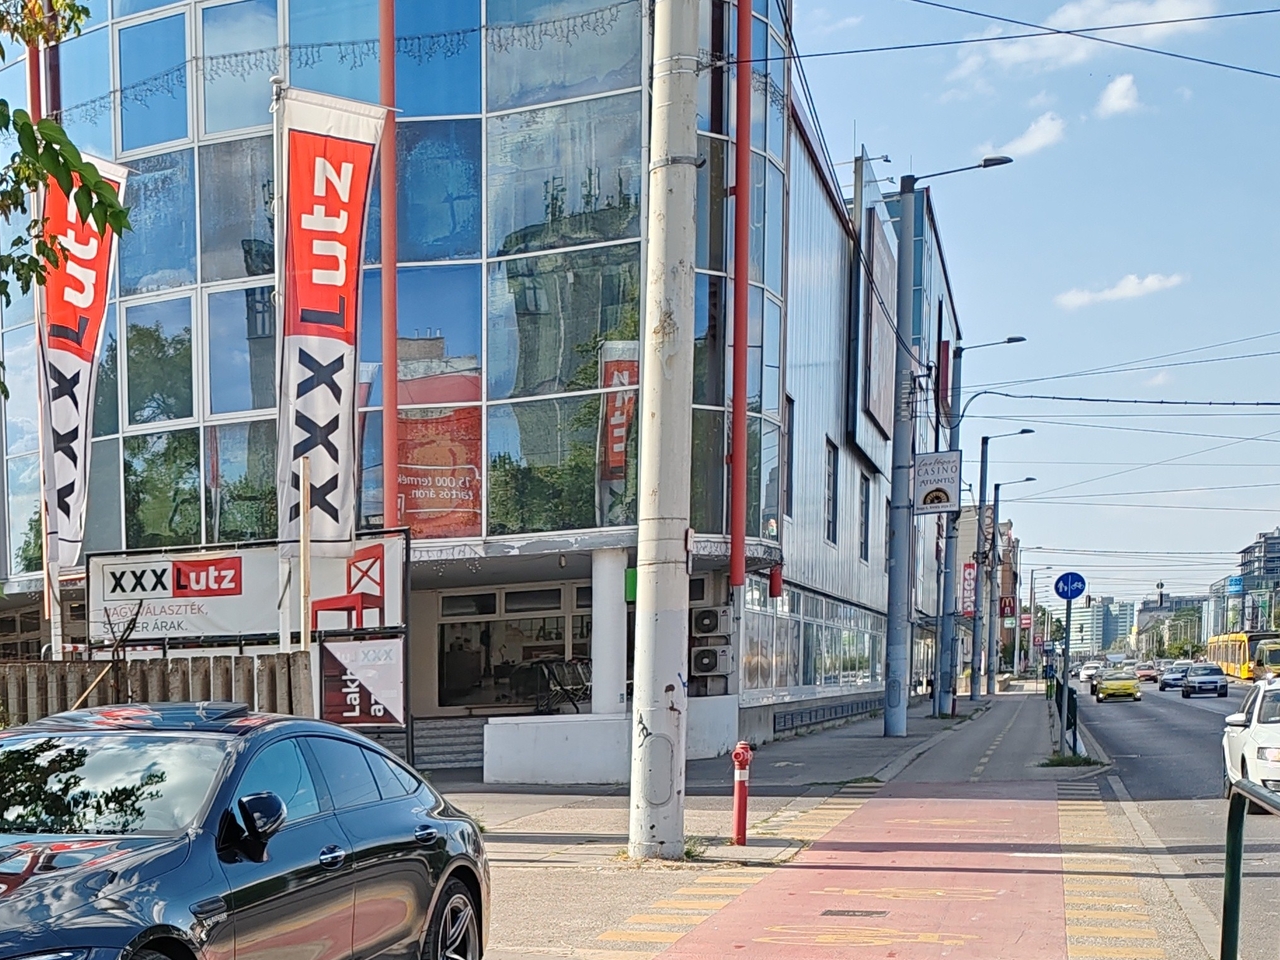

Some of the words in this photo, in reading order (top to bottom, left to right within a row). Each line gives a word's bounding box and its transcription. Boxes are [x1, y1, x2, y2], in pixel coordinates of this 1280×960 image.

[289, 157, 354, 524] XXXLutz
[917, 465, 958, 477] CASINO
[920, 477, 956, 487] ATLANTIS
[110, 565, 236, 594] XXXLutz
[964, 568, 975, 612] DIEGO
[103, 605, 137, 619] NAGY
[152, 618, 188, 633] ÁRAK.
